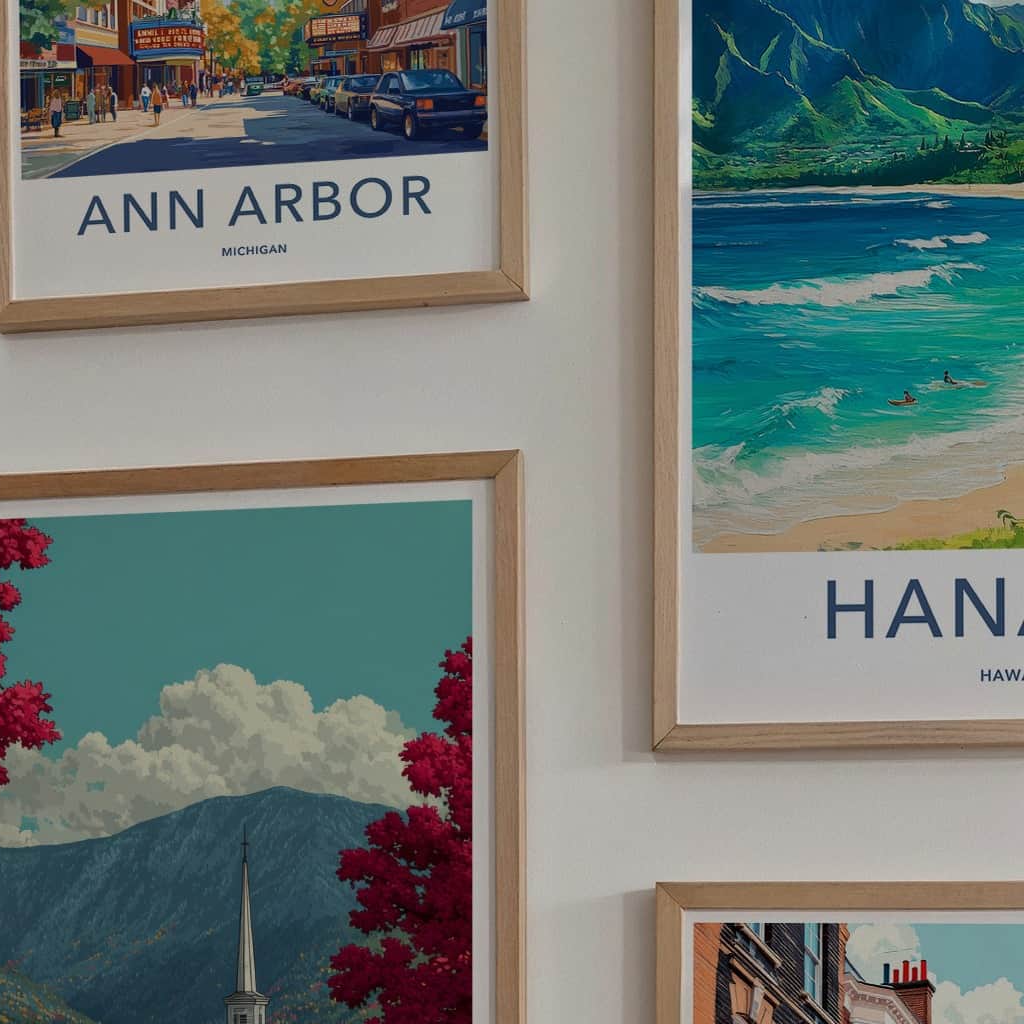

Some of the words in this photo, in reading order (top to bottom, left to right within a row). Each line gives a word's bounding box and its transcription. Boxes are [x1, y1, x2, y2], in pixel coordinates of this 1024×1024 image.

[77, 188, 204, 236] ANN
[228, 175, 432, 227] ARBOR
[221, 244, 287, 257] MICHIGAN
[827, 577, 1024, 639] HAN
[980, 669, 1024, 682] HAW
